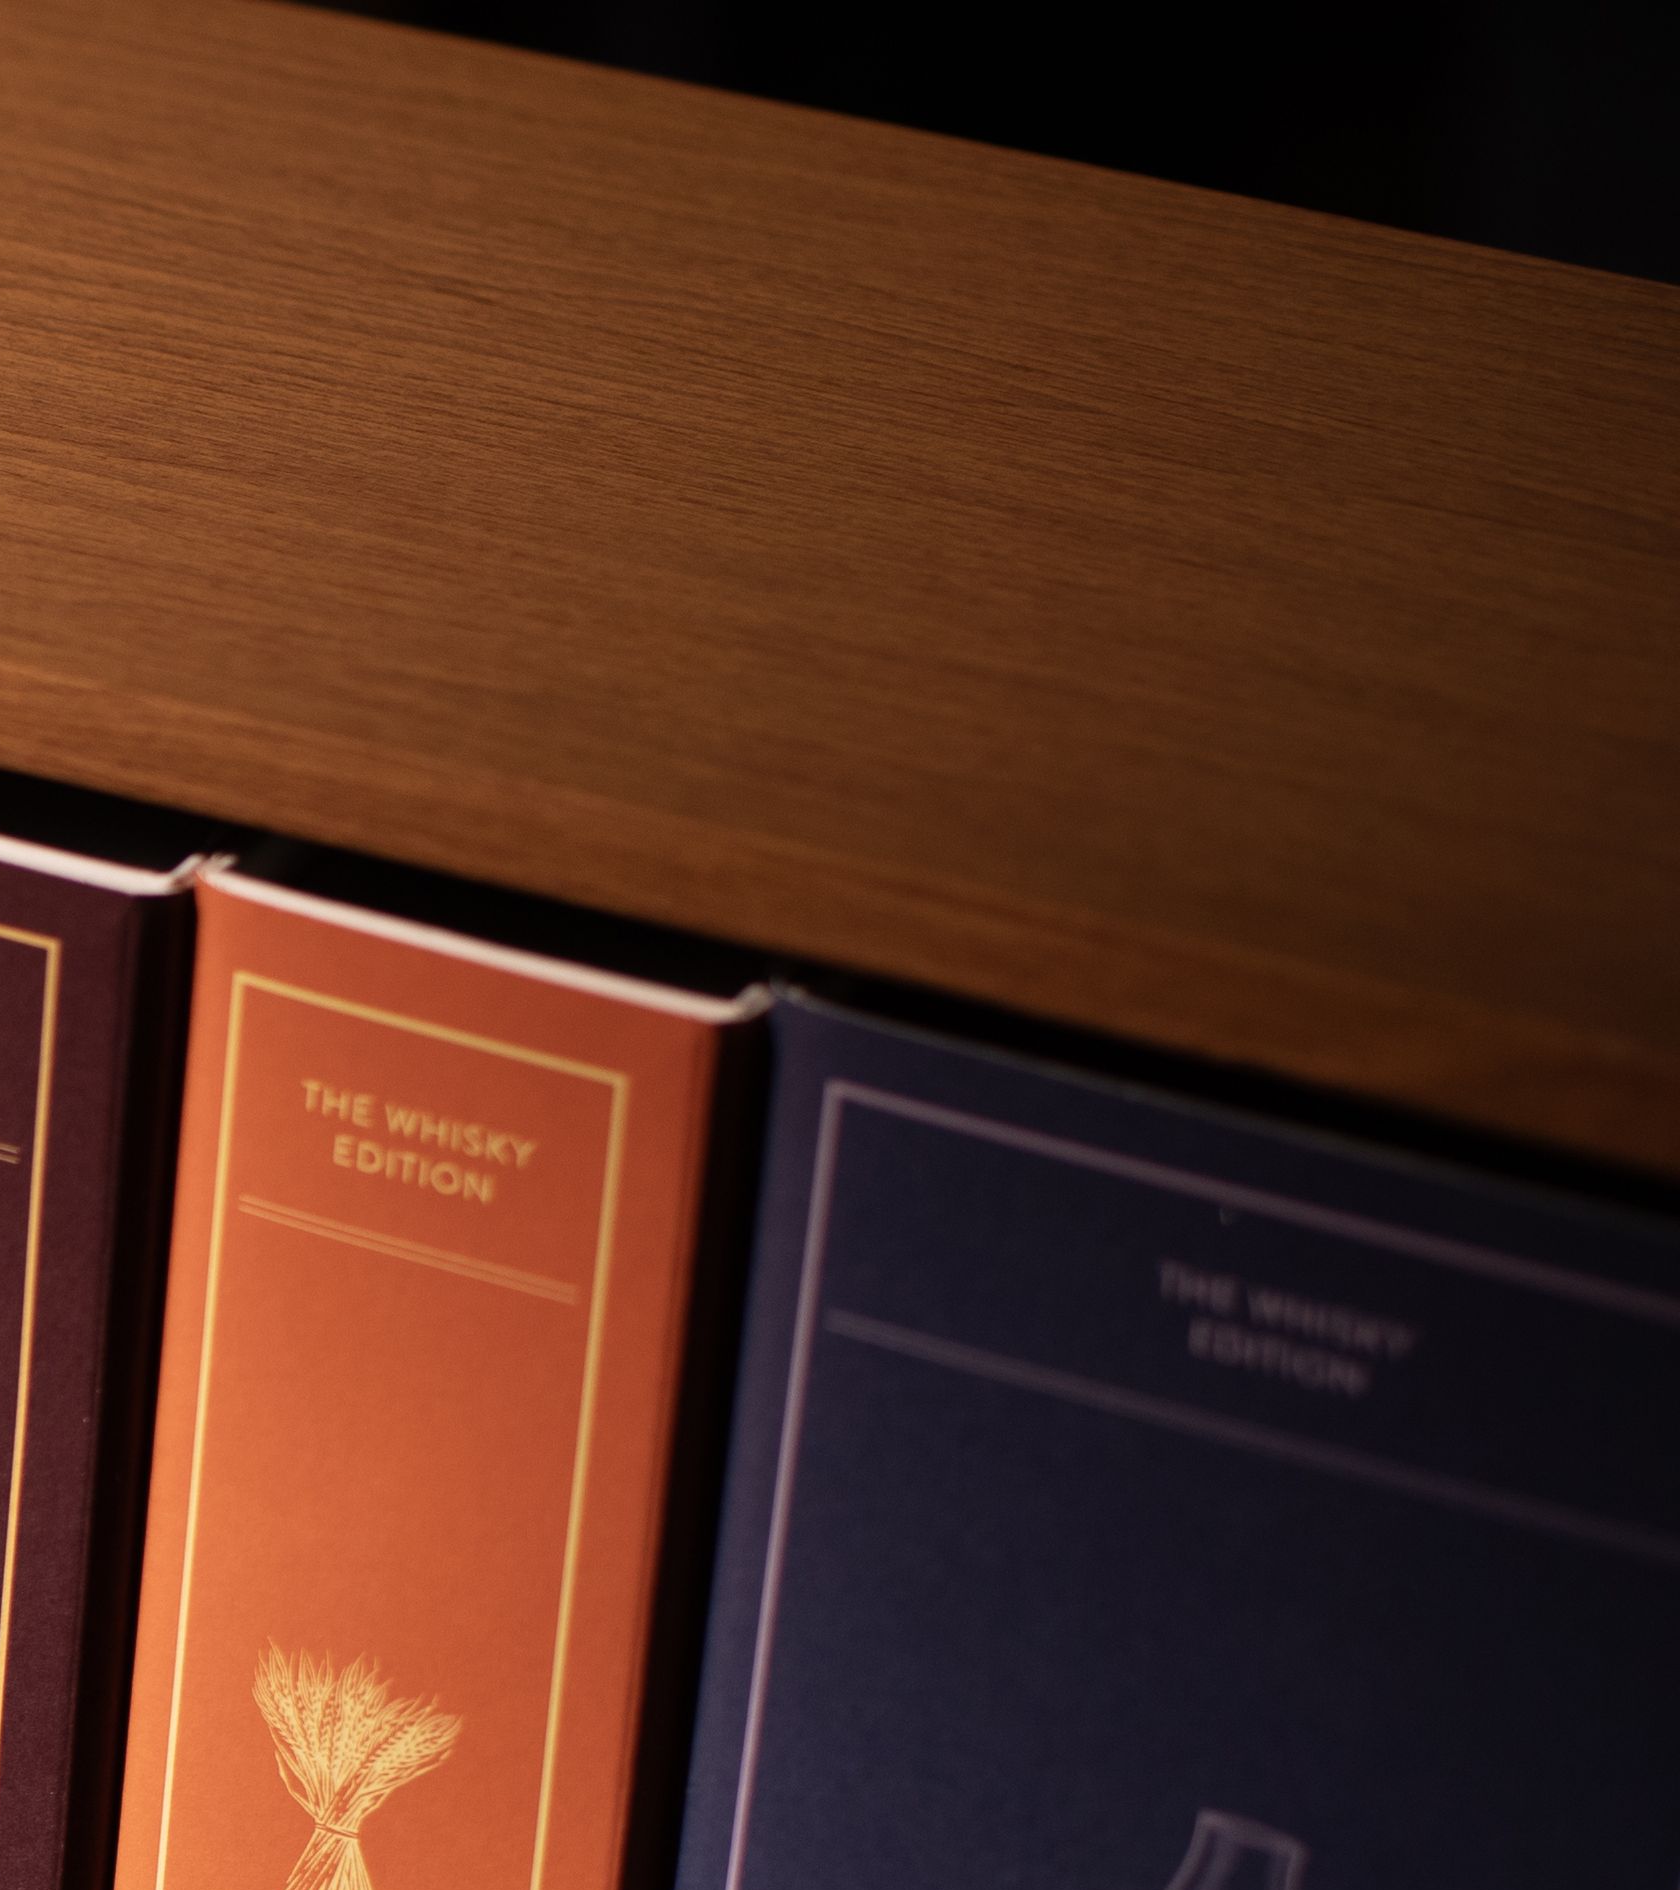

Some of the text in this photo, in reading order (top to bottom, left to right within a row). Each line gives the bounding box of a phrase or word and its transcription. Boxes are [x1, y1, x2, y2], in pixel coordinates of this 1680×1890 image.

[302, 1080, 538, 1171] THE WHISKY
[332, 1134, 495, 1204] EDITION
